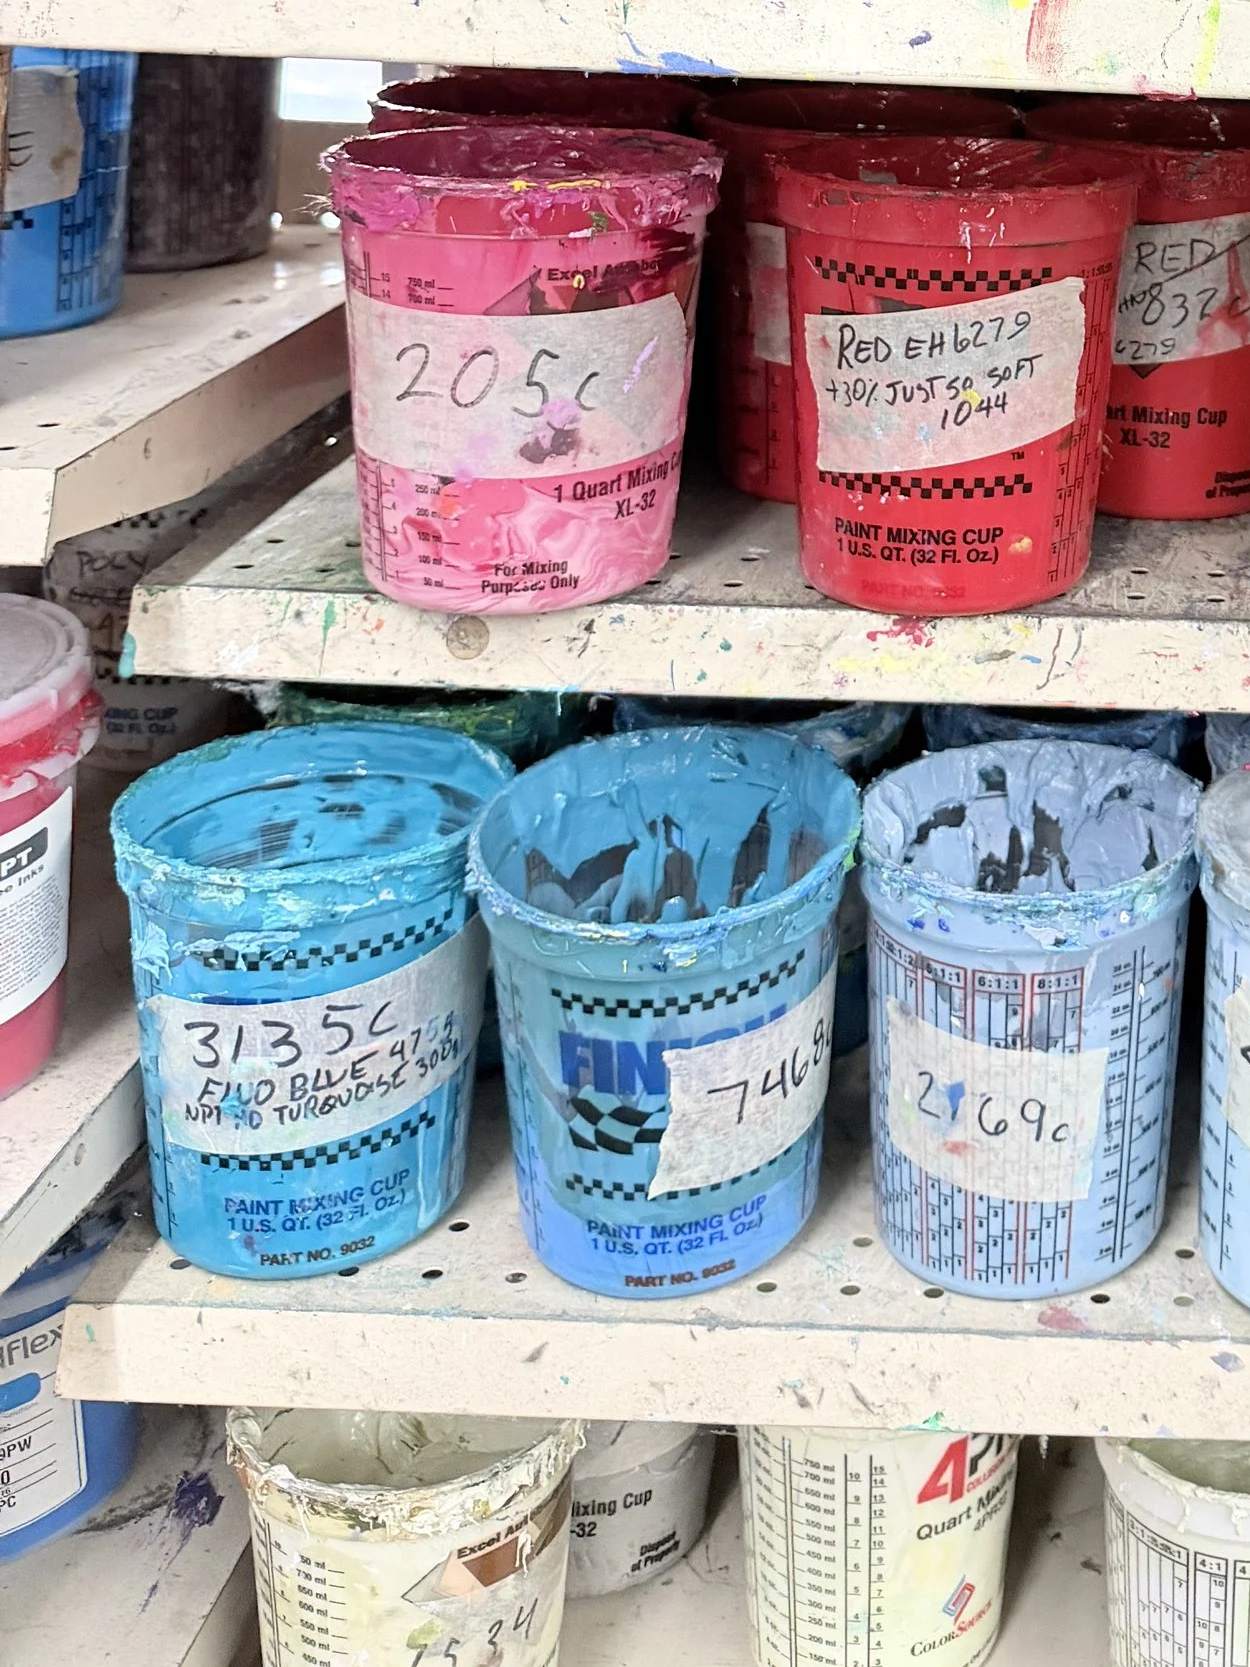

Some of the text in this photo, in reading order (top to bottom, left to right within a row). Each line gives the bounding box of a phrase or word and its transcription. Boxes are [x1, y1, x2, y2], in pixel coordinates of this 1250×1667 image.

[1135, 238, 1217, 274] RED
[837, 323, 892, 369] RED
[886, 376, 946, 407] JUST
[941, 392, 1009, 430] 1044
[1132, 406, 1228, 429] Mixing Cup
[1119, 428, 1171, 449] XL-32
[572, 462, 670, 501] Quart Mixing
[614, 489, 657, 520] XL-32
[834, 516, 1004, 546] PAINT MIXING CUP
[494, 559, 568, 577] For Mixing
[847, 542, 876, 560] U.S.
[880, 546, 905, 564] QT.
[910, 546, 936, 567] (32
[224, 1169, 410, 1217] PAINT CUP
[587, 1194, 767, 1241] PAINT MIXING CUP
[623, 1488, 653, 1511] Cup
[917, 1506, 972, 1540] Quart
[457, 1532, 501, 1560] Excel
